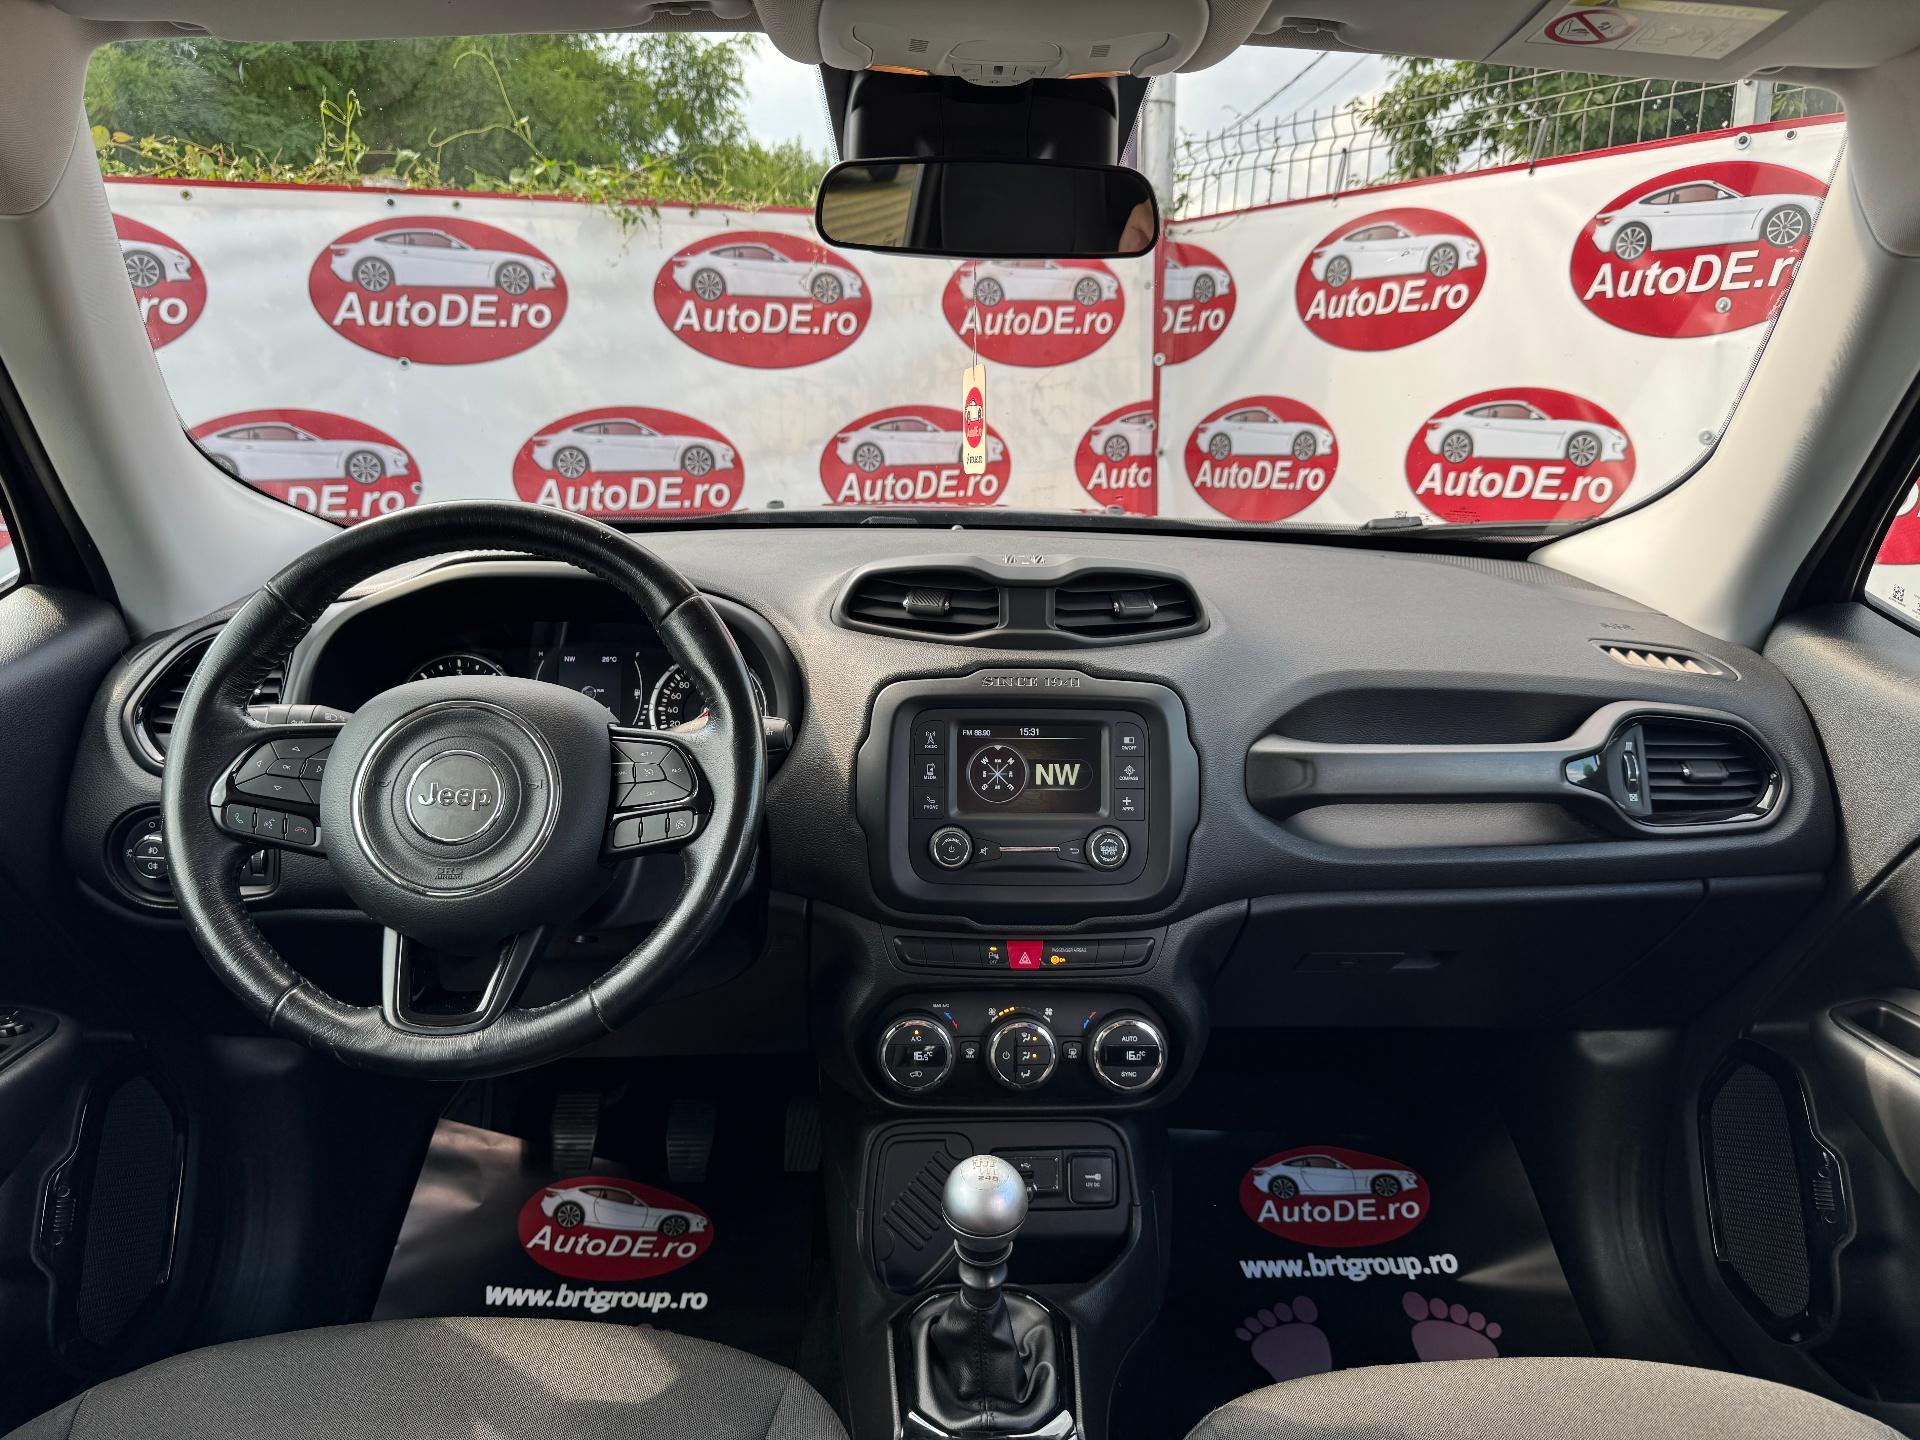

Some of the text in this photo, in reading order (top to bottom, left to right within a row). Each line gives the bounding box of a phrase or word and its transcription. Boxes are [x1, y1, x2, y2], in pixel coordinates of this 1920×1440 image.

[1583, 250, 1802, 300] AutoDE.r
[332, 291, 553, 329] AutoDE.ro
[1303, 279, 1469, 322] AutoDE.ro
[673, 299, 858, 336] AutoDE.ro
[959, 305, 1113, 336] AutoDE.ro
[836, 469, 999, 502] AutoDE.ro
[1193, 459, 1326, 491] AutoDE.ro
[1415, 462, 1613, 504] AutoDE.ro
[536, 477, 732, 512] AutoDE.ro
[678, 681, 690, 689] 80
[981, 676, 1081, 688] SINCE 1941
[667, 706, 679, 714] 40
[1019, 727, 1040, 736] 15:31
[1035, 763, 1081, 786] NW
[418, 782, 492, 812] Jeep
[1257, 1198, 1420, 1223] AutoDE.ro
[526, 1225, 697, 1259] AutoDE.ro
[1239, 1252, 1458, 1282] www.brtgroup.ro
[485, 1284, 708, 1314] www.brtgroup.ro
